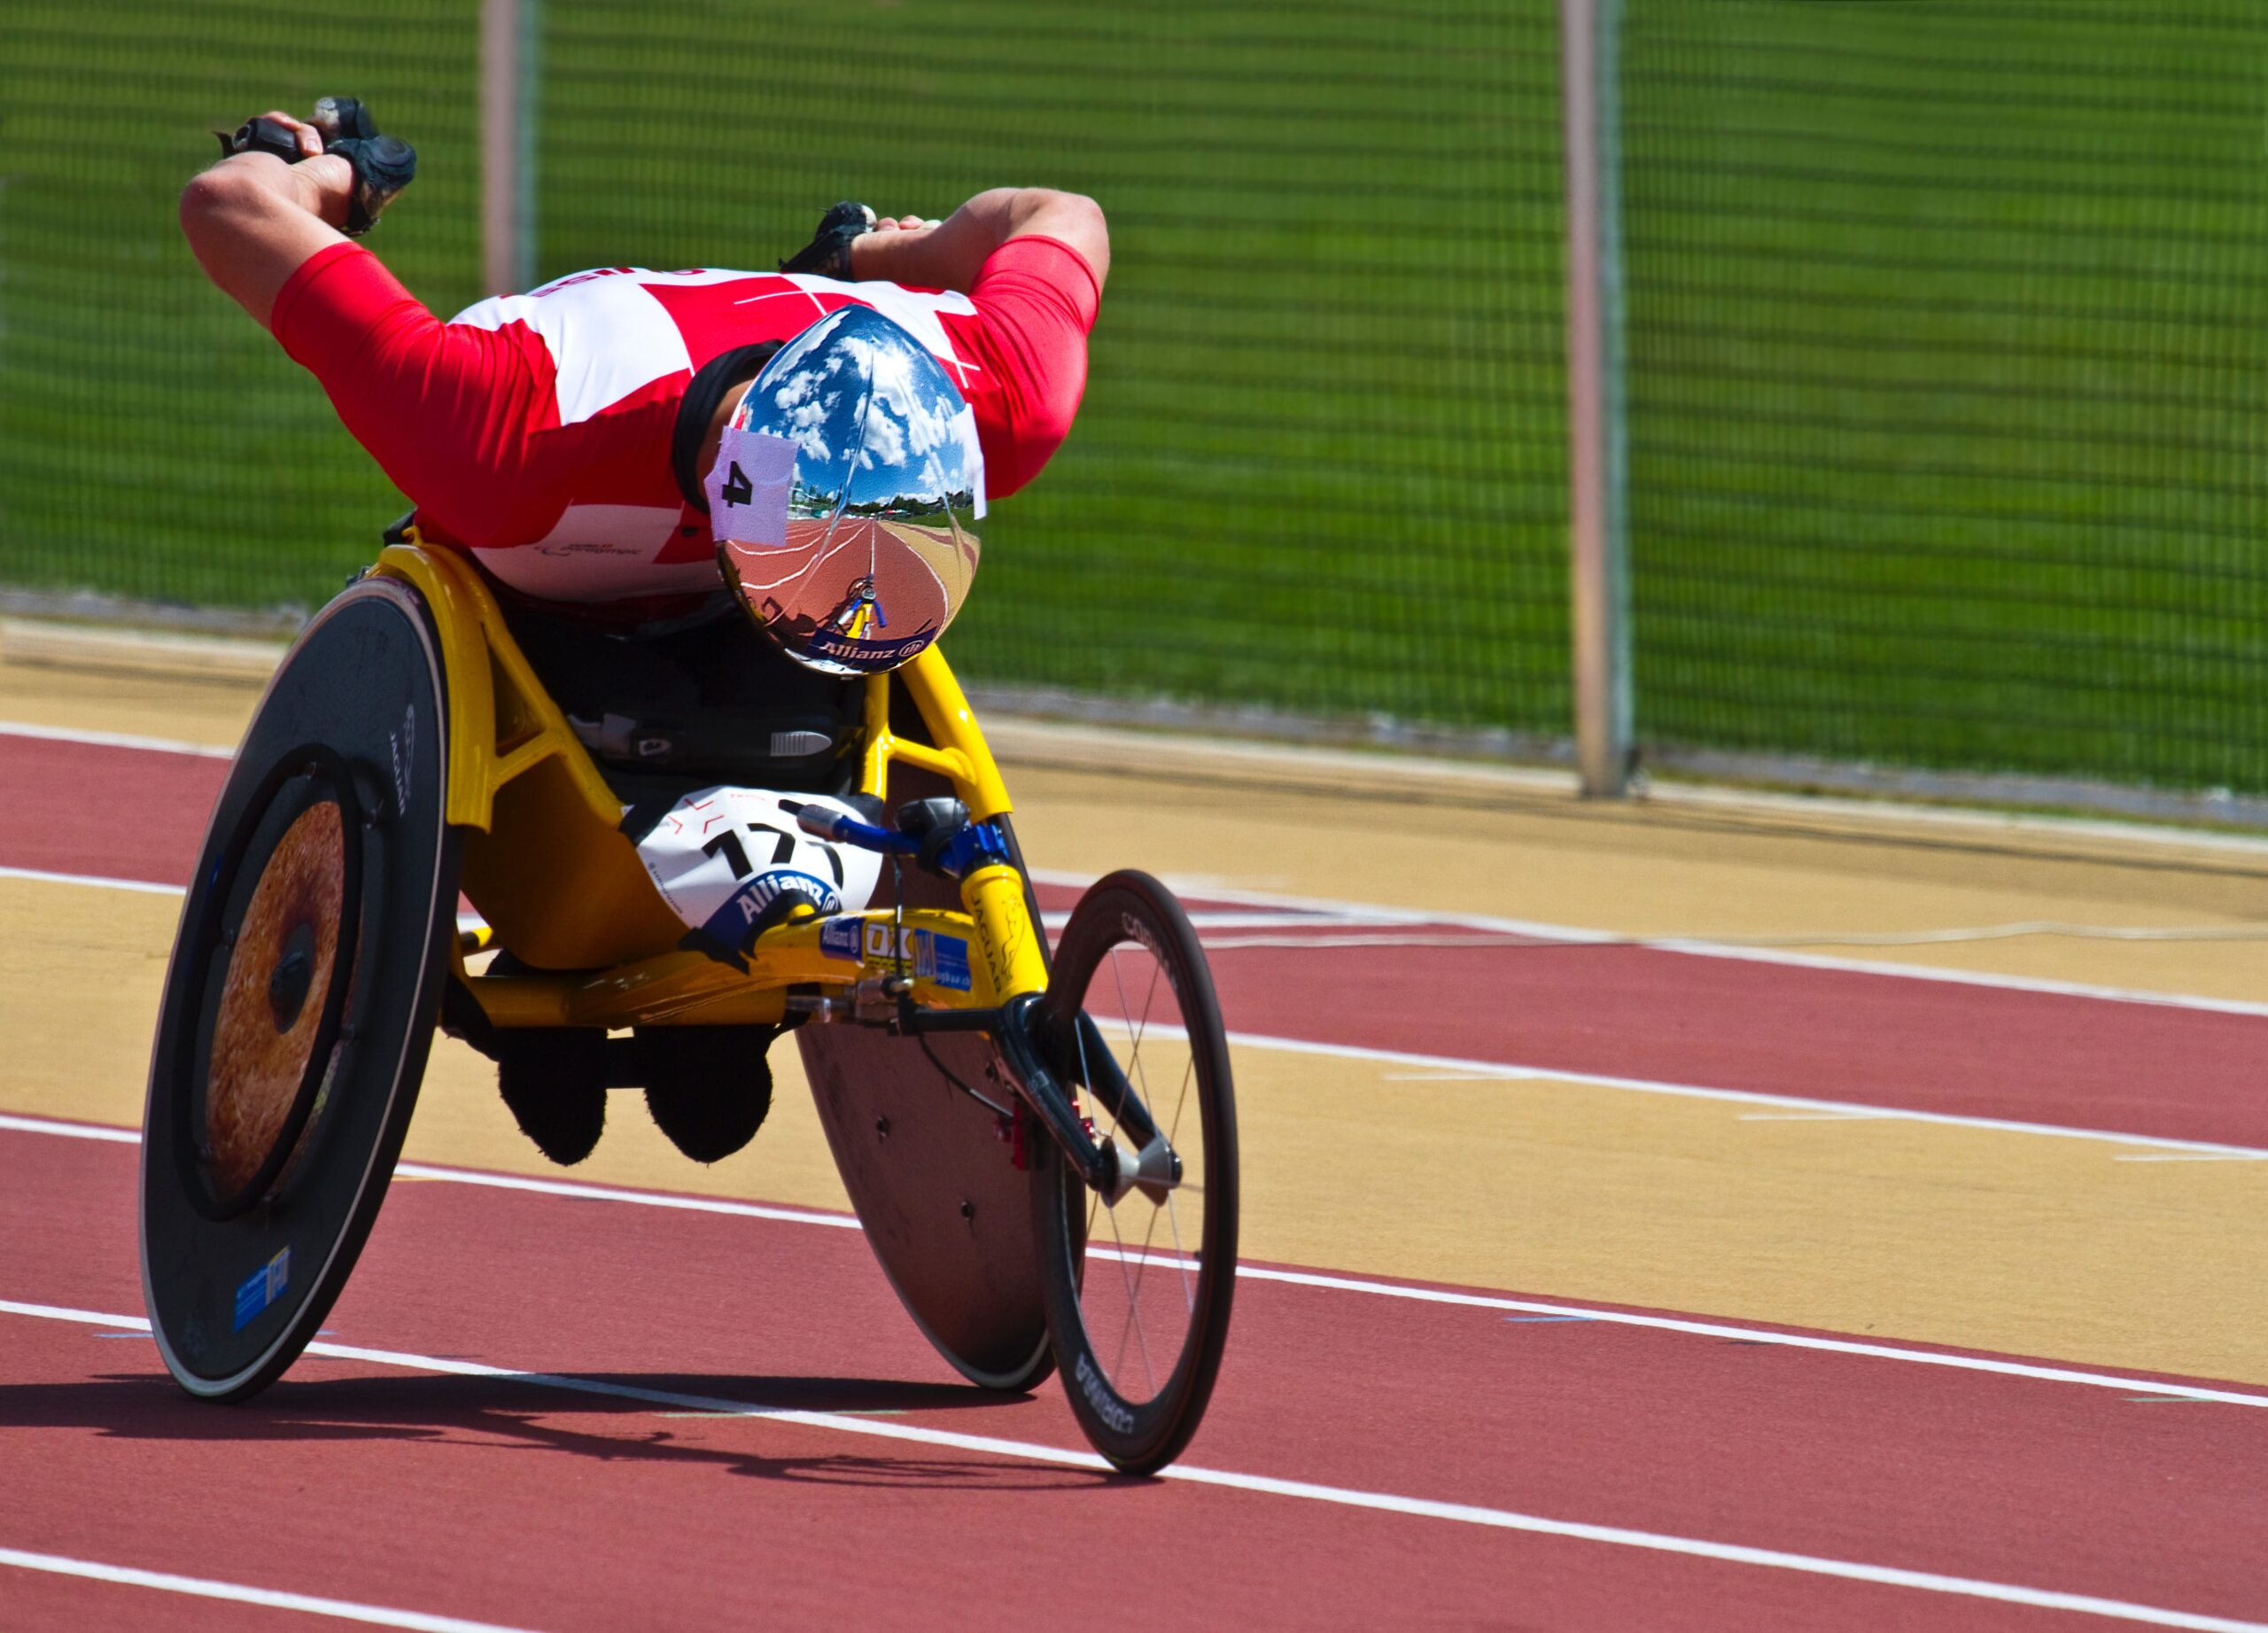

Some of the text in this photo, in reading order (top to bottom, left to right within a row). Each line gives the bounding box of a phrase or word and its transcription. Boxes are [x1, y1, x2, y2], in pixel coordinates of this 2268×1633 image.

[722, 461, 752, 508] 4
[819, 642, 897, 660] Allianz
[736, 874, 824, 925] Allianz
[866, 923, 913, 959] OX
[971, 893, 1001, 996] JAGUAR
